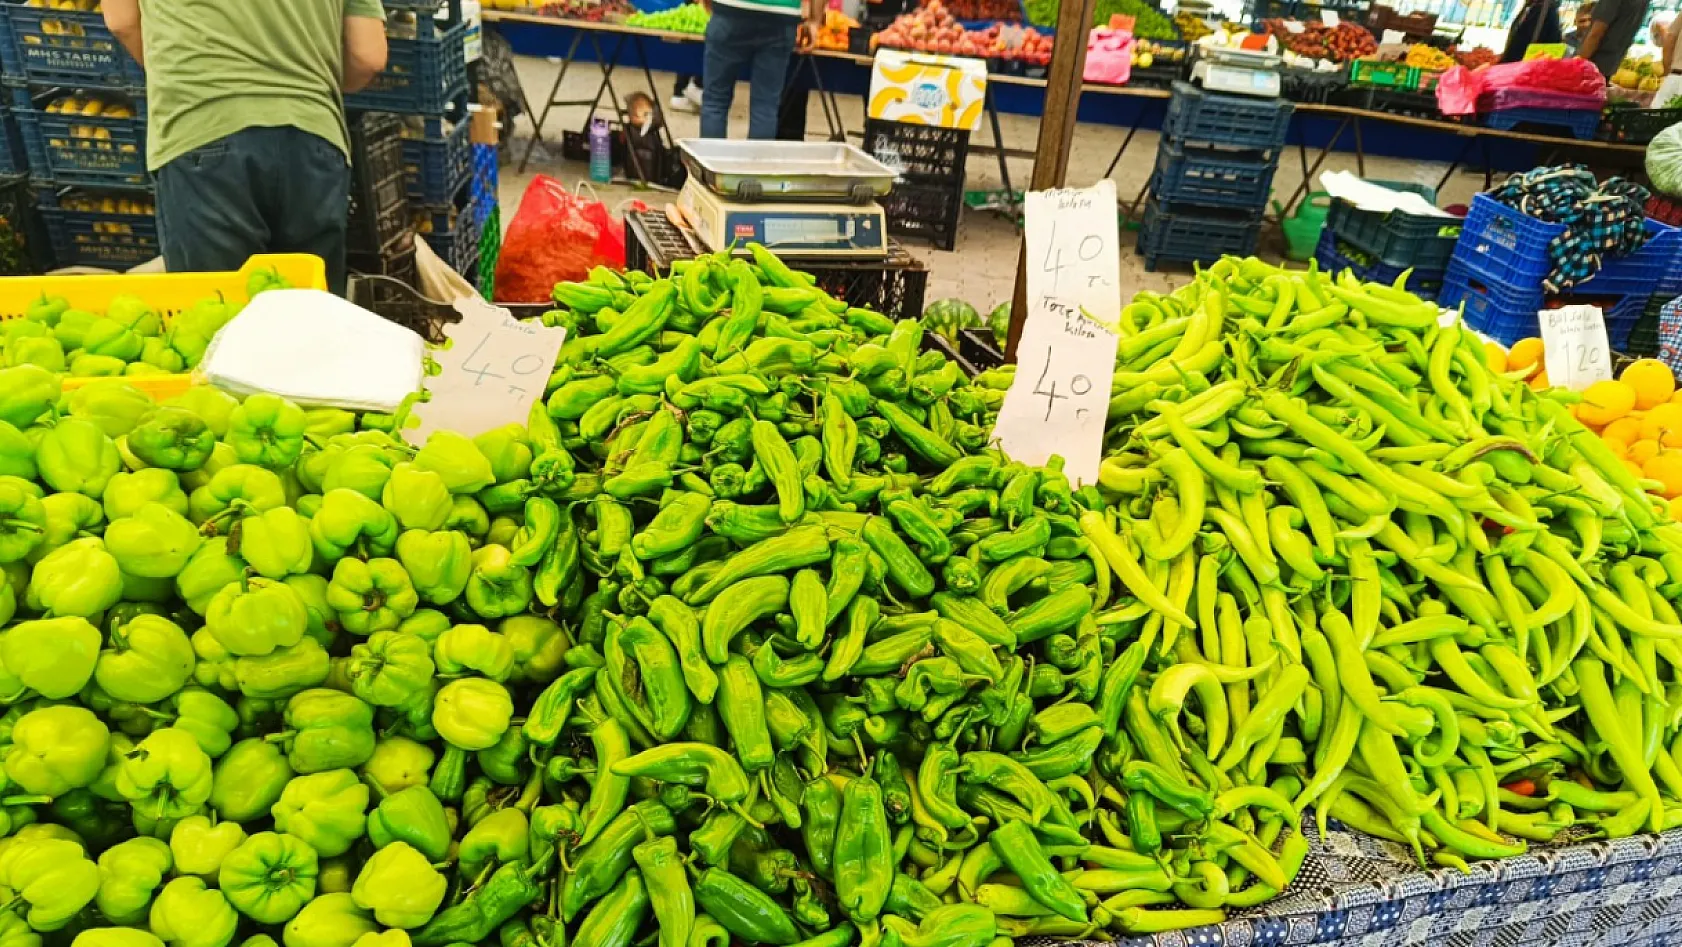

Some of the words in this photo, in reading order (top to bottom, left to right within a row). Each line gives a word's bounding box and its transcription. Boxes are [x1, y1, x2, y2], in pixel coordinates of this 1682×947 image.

[1043, 219, 1104, 293] 40
[461, 331, 544, 387] 40
[1032, 344, 1093, 423] 40
